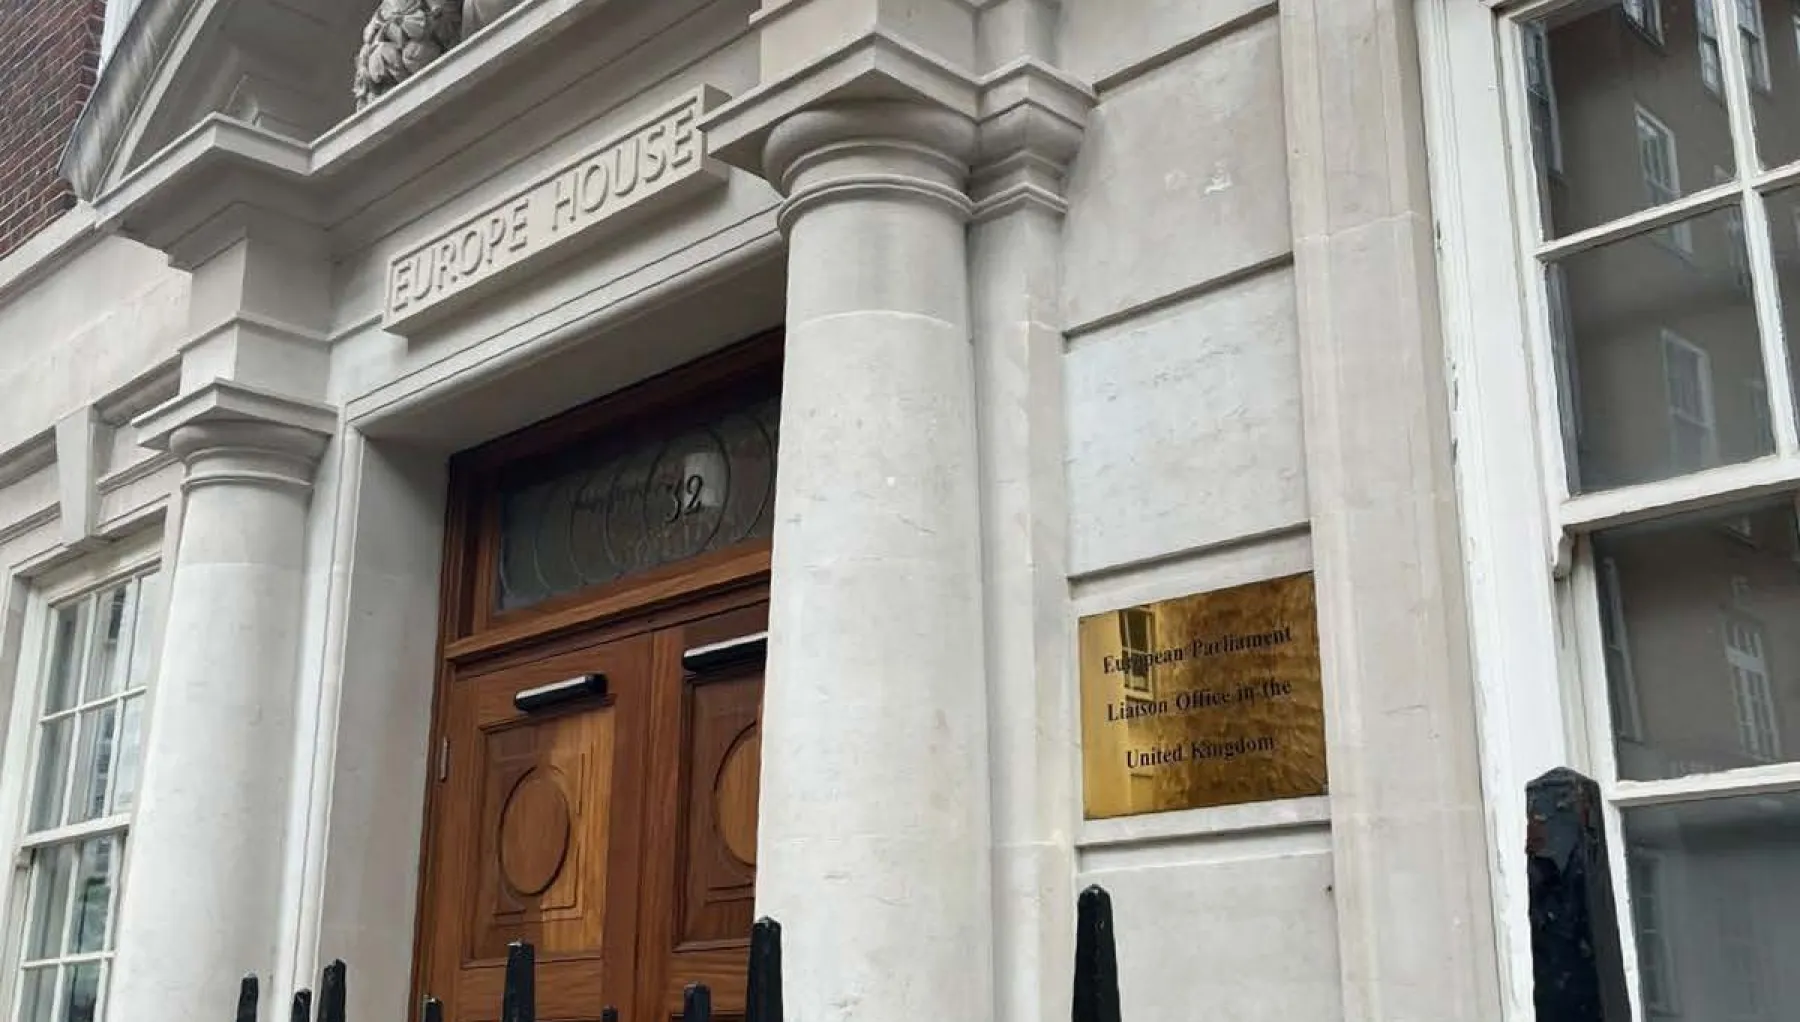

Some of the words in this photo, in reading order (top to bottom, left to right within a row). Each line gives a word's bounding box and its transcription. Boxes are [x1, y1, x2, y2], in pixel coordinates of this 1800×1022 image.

[392, 198, 529, 312] EUROPE
[551, 109, 694, 231] HOUSE
[664, 475, 703, 523] 32
[1103, 647, 1183, 674] European
[1191, 625, 1293, 658] Parliament
[1107, 699, 1168, 721] Liaison
[1175, 688, 1231, 710] Office
[1236, 682, 1256, 701] in
[1262, 678, 1292, 698] the
[1127, 744, 1183, 768] United
[1191, 735, 1274, 761] Kingdom
